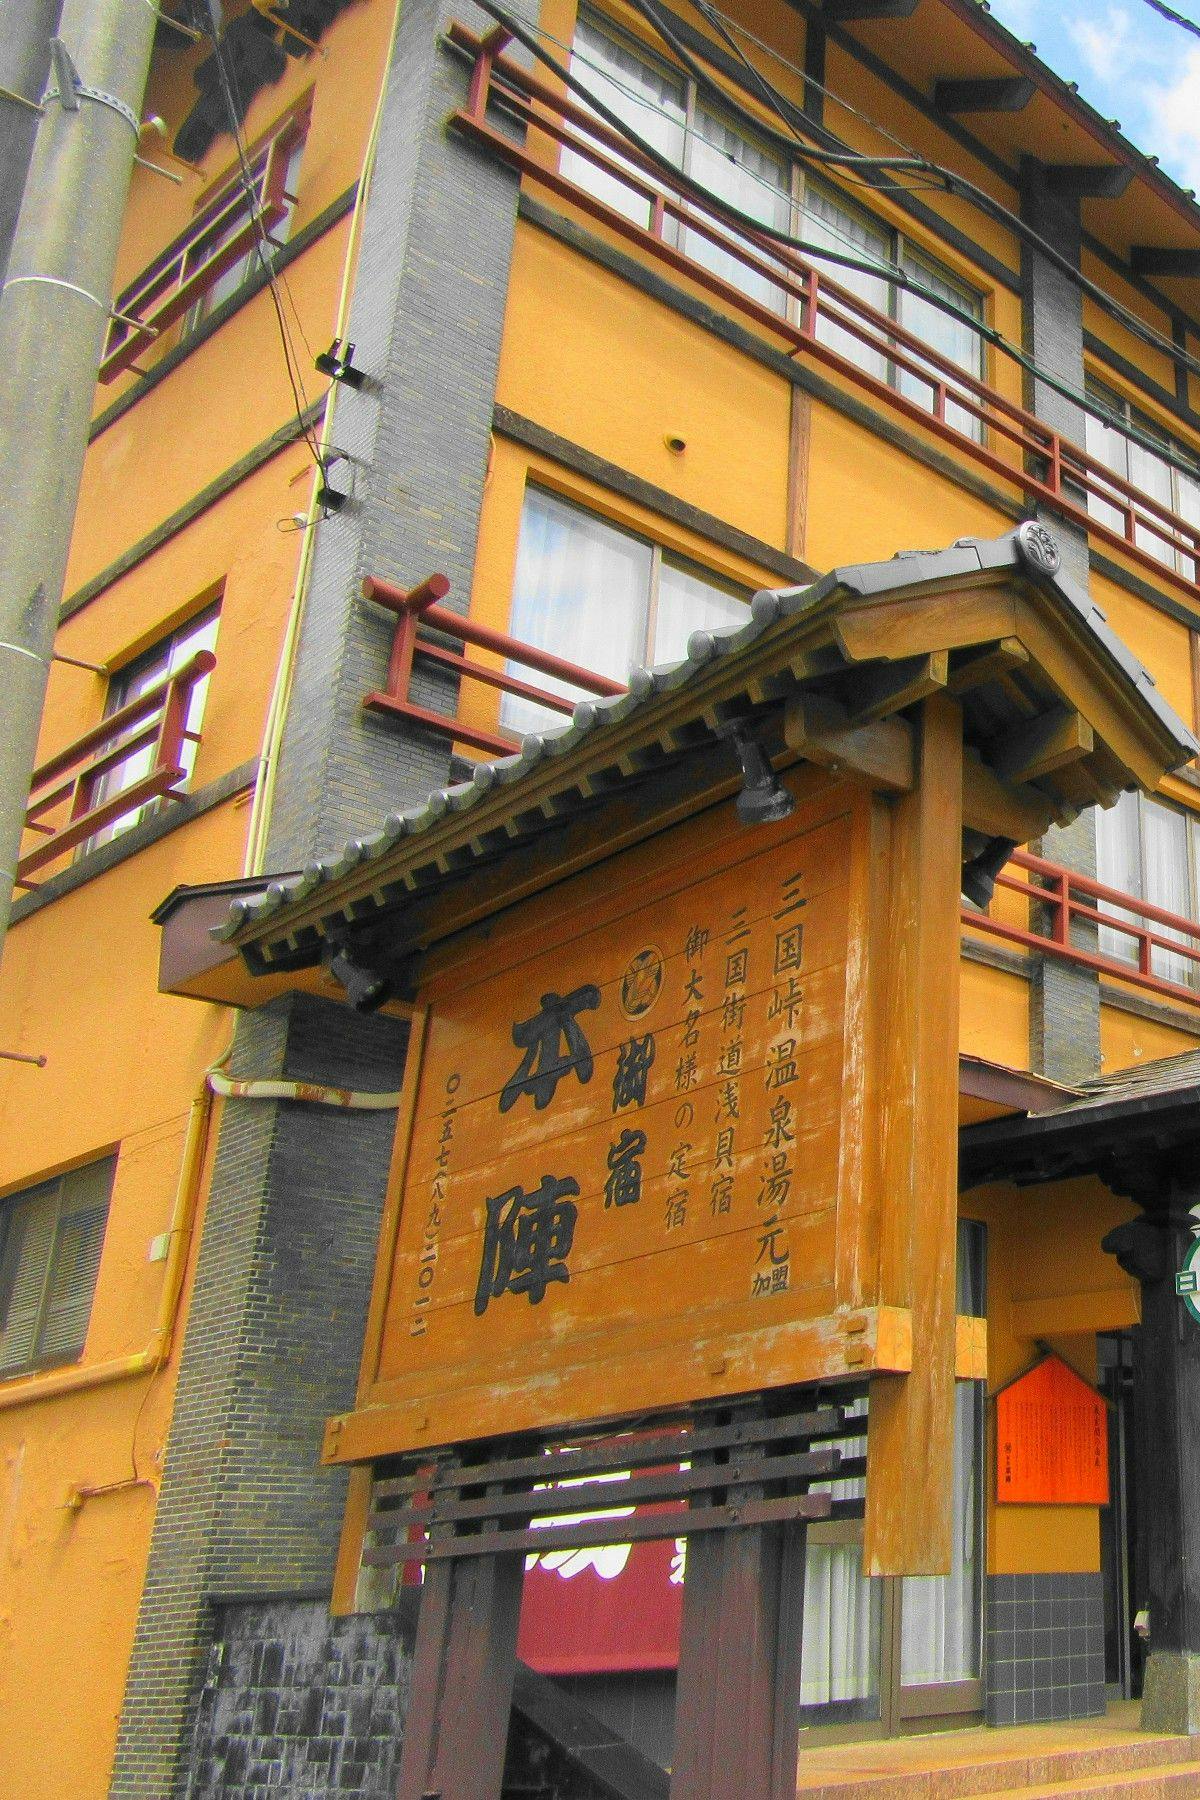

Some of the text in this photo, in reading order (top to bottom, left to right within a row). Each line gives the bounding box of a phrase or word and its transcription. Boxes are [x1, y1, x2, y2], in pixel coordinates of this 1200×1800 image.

[664, 925, 709, 1232] 御大名様の定宿
[710, 906, 750, 1216] 三国街道浅貝宿
[755, 872, 808, 1264] 三国峠温泉湯元
